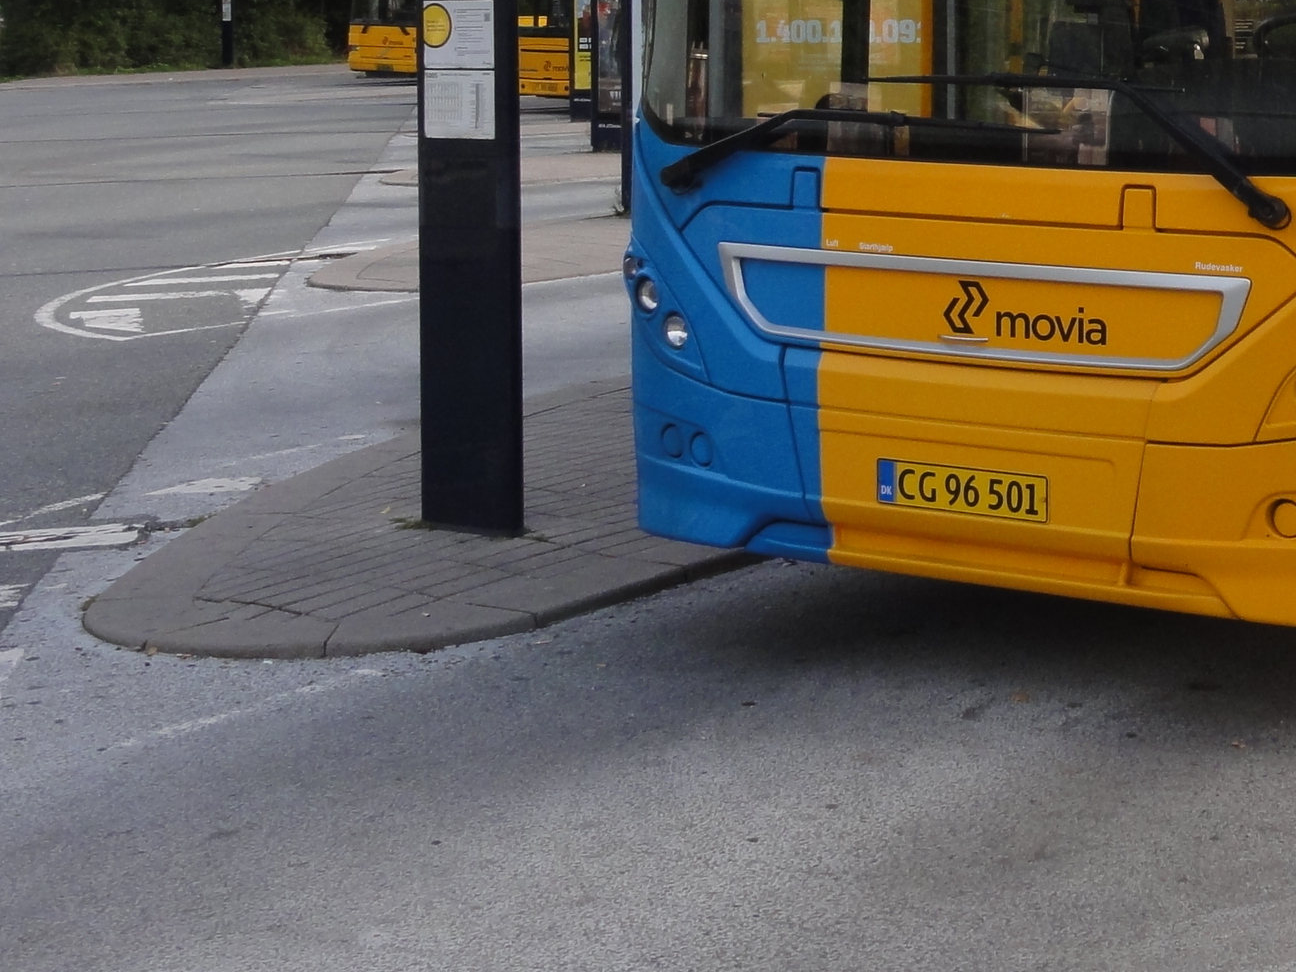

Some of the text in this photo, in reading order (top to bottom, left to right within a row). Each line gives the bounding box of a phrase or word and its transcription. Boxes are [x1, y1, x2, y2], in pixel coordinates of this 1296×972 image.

[825, 238, 839, 247] Luft
[1194, 261, 1244, 273] Rudevasker
[996, 307, 1107, 346] movia
[880, 485, 893, 496] DK
[898, 468, 1039, 516] CG 96 501
